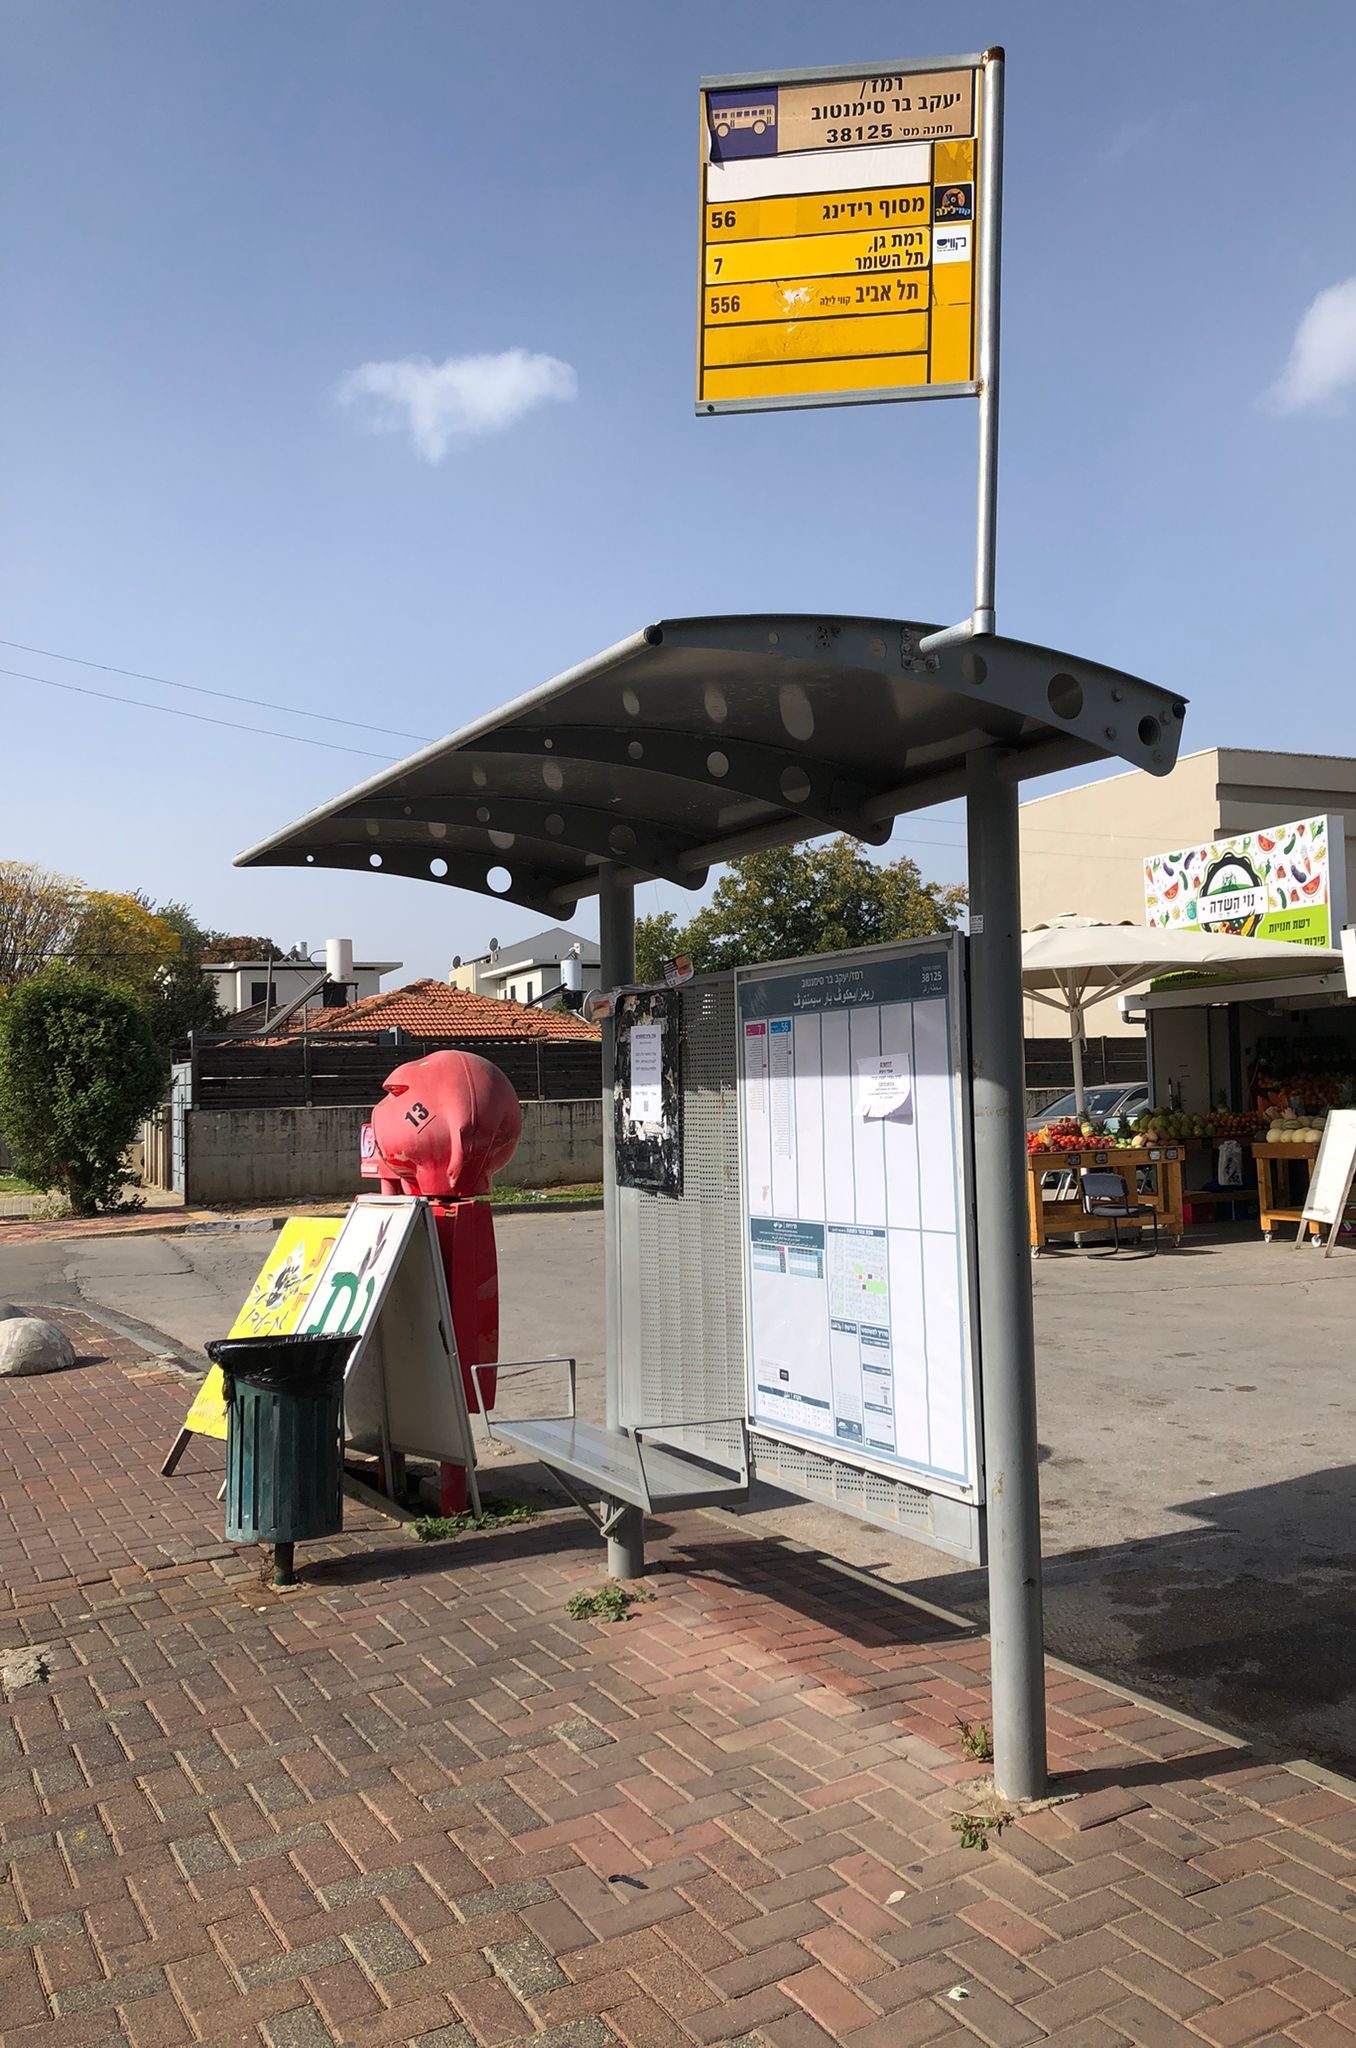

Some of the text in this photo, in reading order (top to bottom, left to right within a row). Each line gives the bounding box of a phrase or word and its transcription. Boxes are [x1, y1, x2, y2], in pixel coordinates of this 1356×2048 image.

[811, 93, 961, 120] יעקב בר סימנטוב
[826, 124, 893, 143] 38125
[923, 124, 953, 135] תחנה
[711, 197, 925, 229] 56 מסוף רידינג
[868, 232, 923, 253] רמת גן,
[713, 249, 923, 275] 7 תל השומר
[855, 284, 891, 303] אביב
[896, 279, 918, 300] תל
[711, 295, 740, 314] 556
[1268, 918, 1310, 933] רשת חנויות
[921, 971, 942, 983] 38125
[757, 1025, 762, 1034] 7
[405, 1102, 429, 1127] 13
